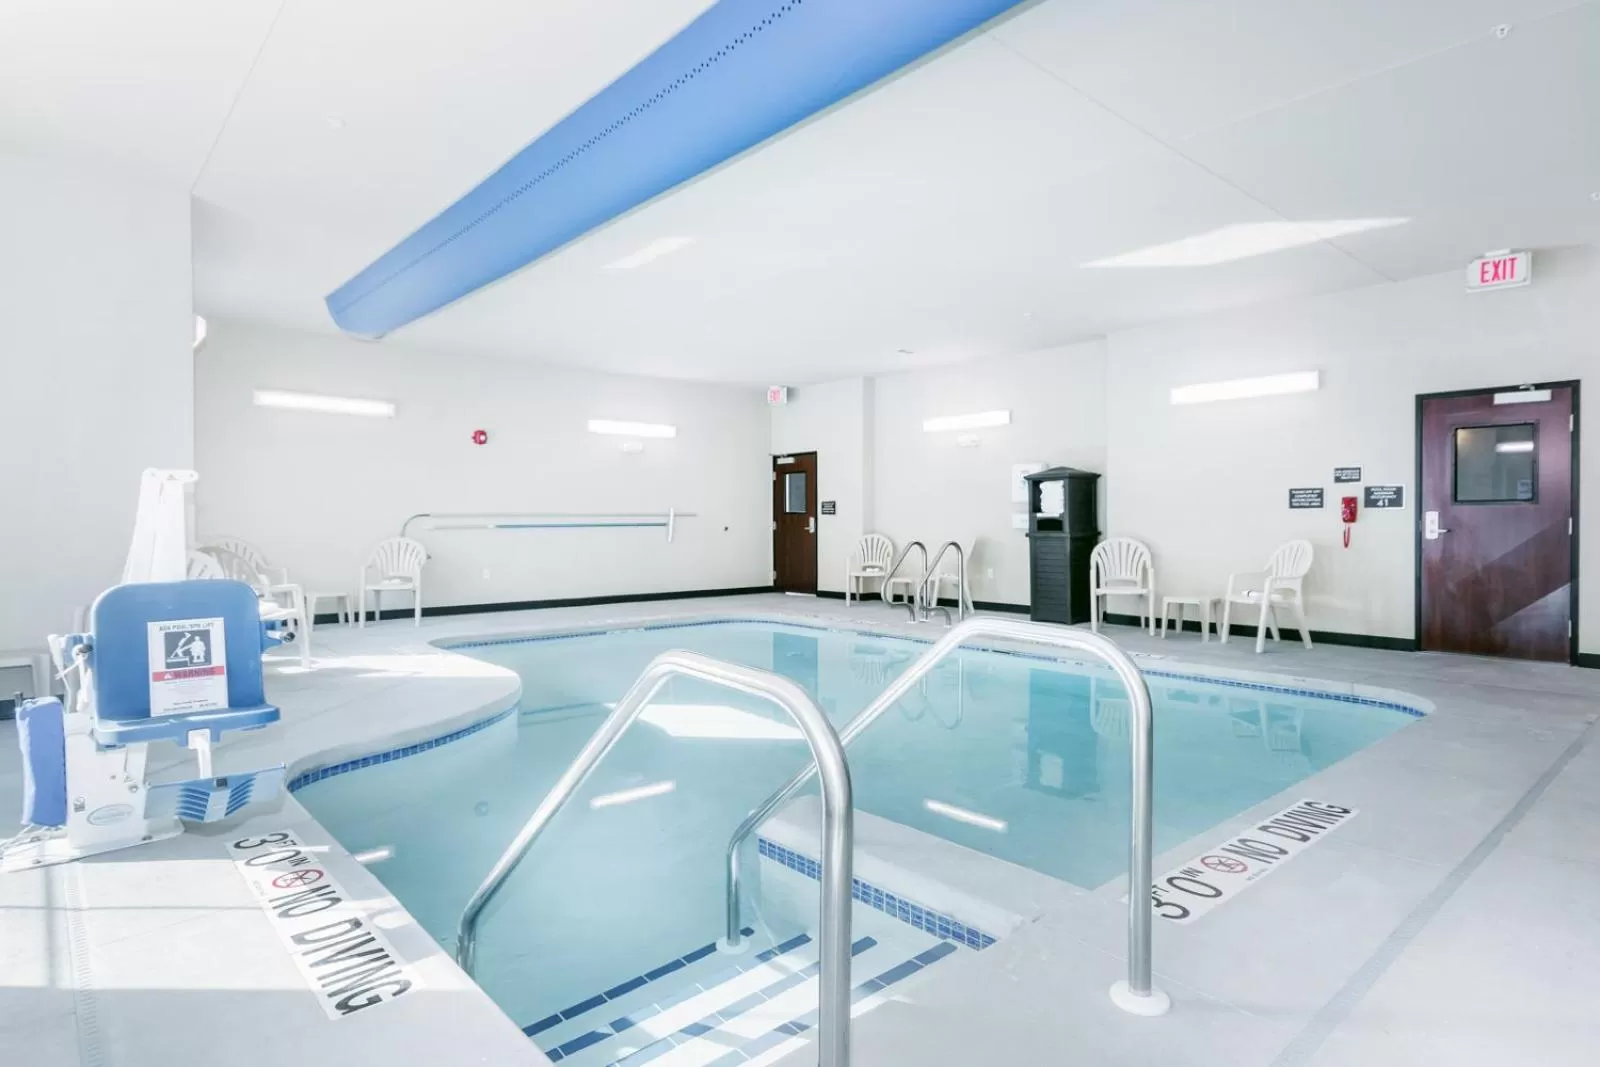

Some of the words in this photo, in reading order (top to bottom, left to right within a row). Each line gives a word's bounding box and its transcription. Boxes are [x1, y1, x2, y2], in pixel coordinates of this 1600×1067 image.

[1481, 257, 1517, 283] EXIT
[1220, 838, 1289, 864] NO
[1257, 801, 1352, 843] DIVING
[268, 884, 343, 918] NO
[290, 917, 412, 1016] DIVING
